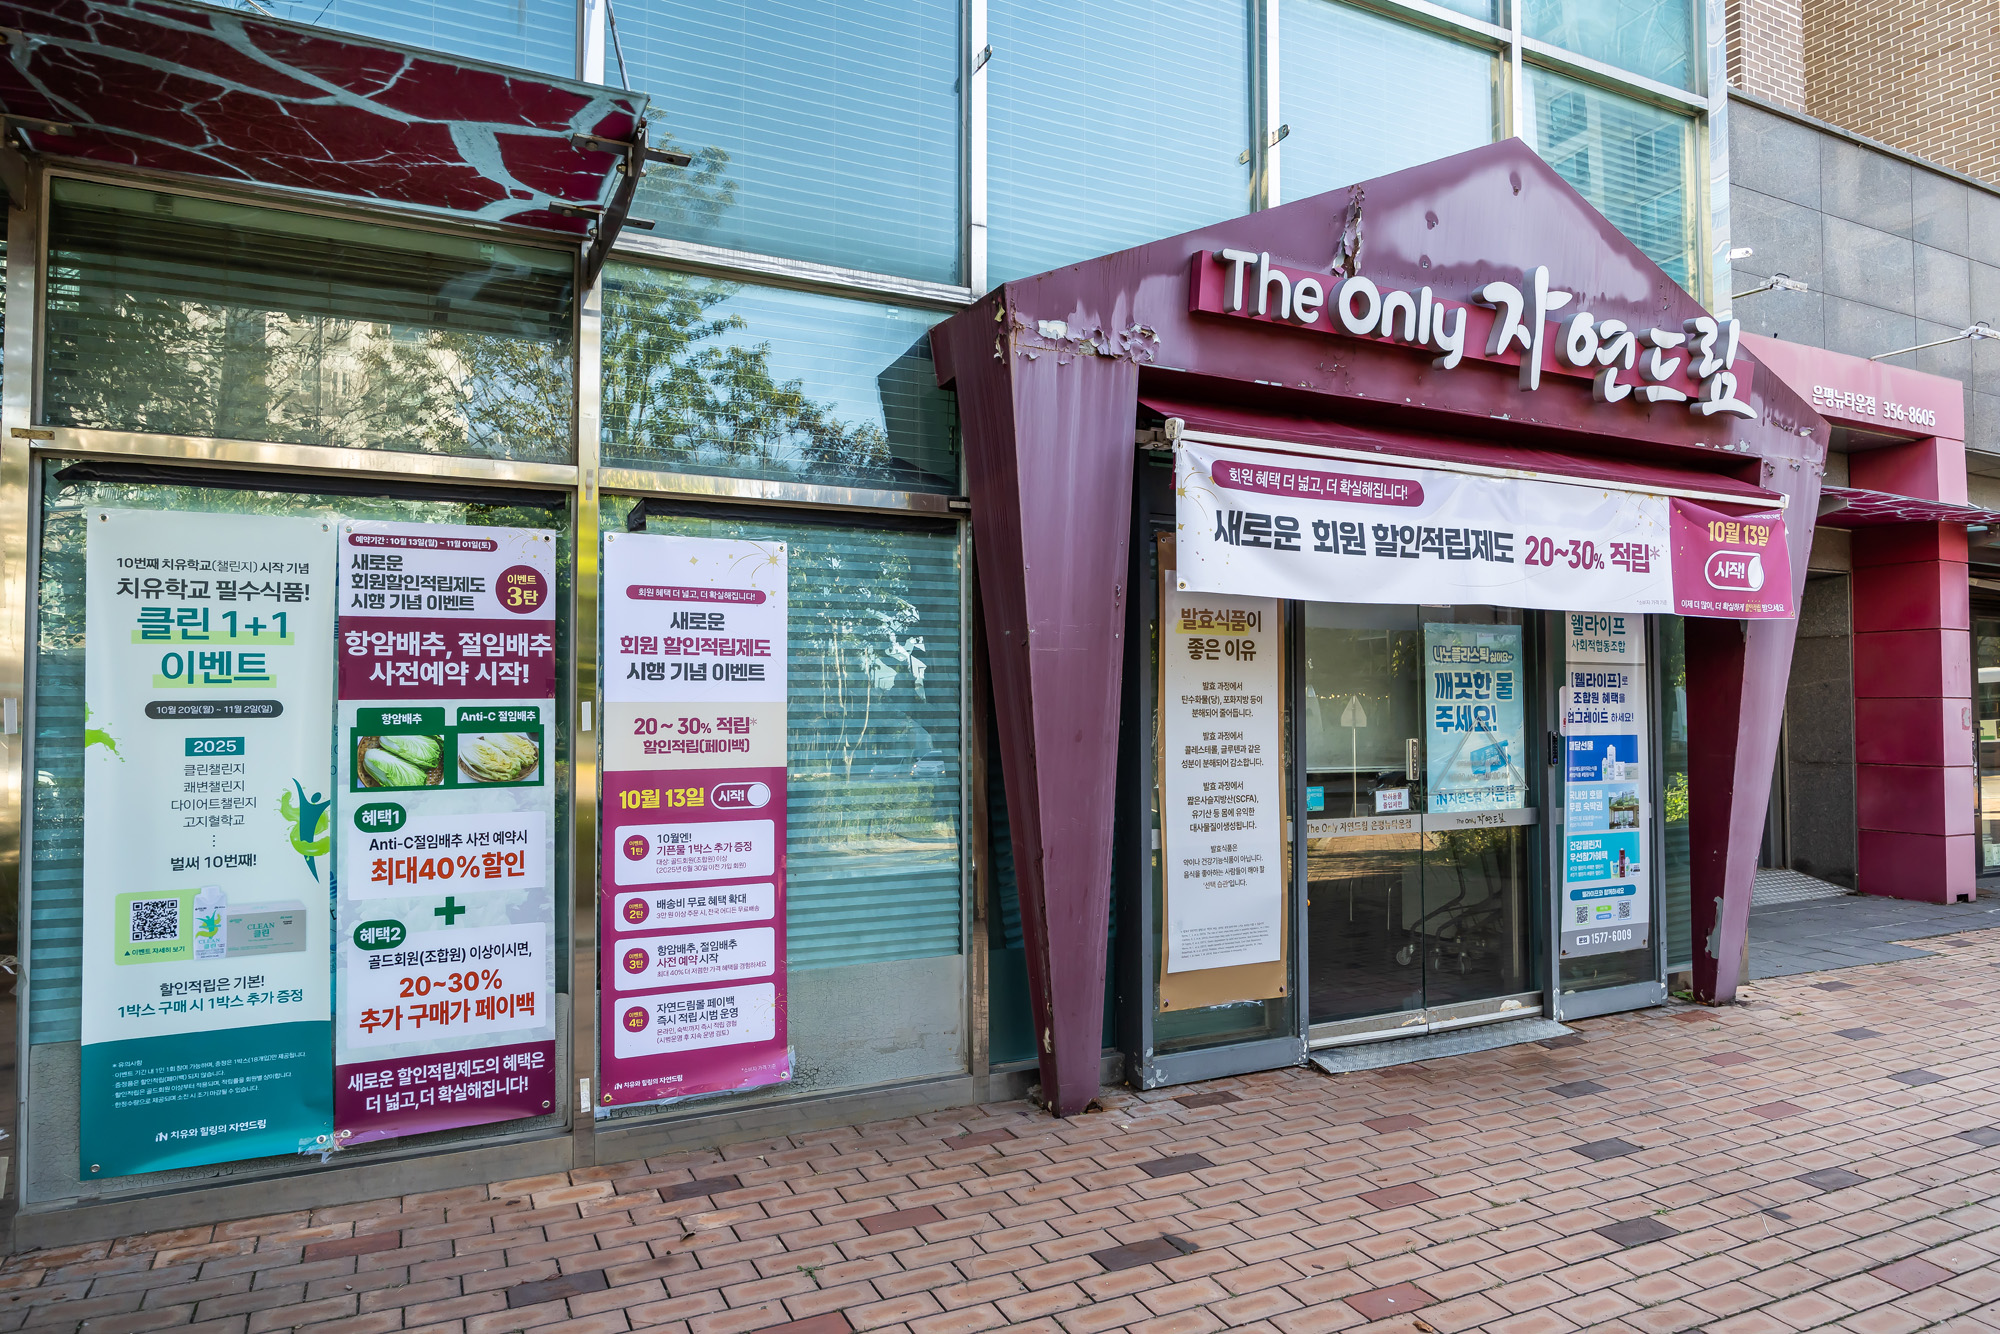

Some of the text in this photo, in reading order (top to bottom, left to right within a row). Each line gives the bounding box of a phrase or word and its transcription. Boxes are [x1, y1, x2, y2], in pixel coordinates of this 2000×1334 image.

[1217, 248, 1758, 419] The Only 자연드림
[1813, 385, 1936, 427] 은평뉴타운점 356-8605
[1229, 468, 1408, 500] 회원 혜택 더 넓고, 더 확실해집니다!
[1214, 510, 1650, 573] 새로운 회원 할인적립제도 20~30% 적립
[1708, 521, 1769, 546] 10월 13일
[356, 536, 385, 545] 예약기간
[390, 538, 407, 546] 10월
[409, 538, 437, 547] 13일(월)
[462, 541, 491, 550] 01일(토)
[117, 557, 309, 574] 10번째 치유학교(챌린지) 시작 기념
[352, 554, 403, 572] 새로운
[1714, 560, 1744, 579] 시작!
[352, 573, 486, 593] 회원할인적립제도
[507, 574, 537, 585] 이벤트
[116, 578, 310, 602] 치유학교 필수식품!
[507, 587, 538, 606] 3탄
[351, 593, 474, 611] 시행 기념 이벤트
[137, 607, 287, 640] 클린 1+1
[670, 612, 725, 631] 새로운
[1181, 608, 1261, 632] 발효식품이
[1571, 614, 1626, 636] 웰라이프
[345, 631, 553, 659] 항암배추, 절임배추
[620, 636, 771, 657] 회원 할인적립제도
[1188, 638, 1256, 661] 좋은 이유
[1572, 640, 1625, 653] 사회적협동조합
[1433, 646, 1489, 663] 나노플라스틱
[161, 651, 270, 684] 이벤트
[369, 661, 529, 686] 사전예약 시작!
[1433, 671, 1514, 700] 깨끗한 물
[1571, 672, 1628, 687] [웰라이프]로
[1182, 695, 1262, 705] 탄수화물(당), 포화지방 등이
[1574, 692, 1625, 704] 조합원 혜택을
[157, 705, 273, 714] 10월 20일(월) 11월 2일(일)
[461, 711, 536, 722] Anti-C 절임배추
[1192, 709, 1253, 718] 분해되어 줄어듭니다.
[1568, 712, 1608, 724] 업그레이드
[1611, 713, 1634, 722] 하세요!
[382, 713, 422, 725] 항암배추
[678, 718, 712, 734] 30%
[1435, 705, 1498, 733] 주세요!
[194, 740, 237, 753] 2025
[643, 739, 750, 754] 할인적립(페이백)
[184, 763, 245, 776] 클린챌린지
[184, 781, 245, 793] 쾌변챌린지
[1449, 785, 1516, 804] 자연드림 기픈물
[171, 797, 257, 811] 다이어트챌린지
[619, 788, 704, 809] 10월 13일
[718, 790, 744, 802] 시작!
[1383, 792, 1402, 800] 반려동물
[1570, 802, 1603, 812] 무료 숙박권
[183, 815, 245, 828] 고지혈학교
[362, 810, 399, 826] 혜택1
[1307, 819, 1411, 832] The Only 자연드림 은평뉴타운점
[369, 830, 528, 851] Anti-C절임배추 사전 예약시
[657, 833, 691, 844] 10월엔!
[630, 847, 643, 856] 1탄
[657, 841, 752, 856] 기픈물 1박스 추가 증정
[171, 854, 257, 871] 벌써 10번째!
[371, 850, 525, 885] 최대40%할인
[657, 894, 746, 909] 배송비 무료 혜택 확대
[629, 911, 643, 919] 2탄
[247, 922, 275, 930] CLEAN
[254, 929, 269, 937] 클린
[360, 927, 401, 944] 혜택2
[1591, 929, 1632, 944] 1577-6009
[132, 946, 185, 956] 이벤트 자세히 보기
[369, 942, 532, 970] 골드회원(조합원) 이상이시면,
[657, 939, 737, 956] 항암배추, 절임배추
[629, 960, 643, 969] 3탄
[160, 975, 264, 996] 할인적립은 기본!
[400, 969, 503, 998] 20~30%
[118, 989, 303, 1018] 1박스 구매 시 1박스 추가 증정
[657, 996, 735, 1014] 자연드림몰 페이백
[360, 992, 535, 1034] 추가 구매가 페이백
[629, 1018, 643, 1027] 4탄
[348, 1051, 545, 1092] 새로운 할인적립제도의 혜택은
[171, 1119, 267, 1140] 치유와 힐링의 자연드림
